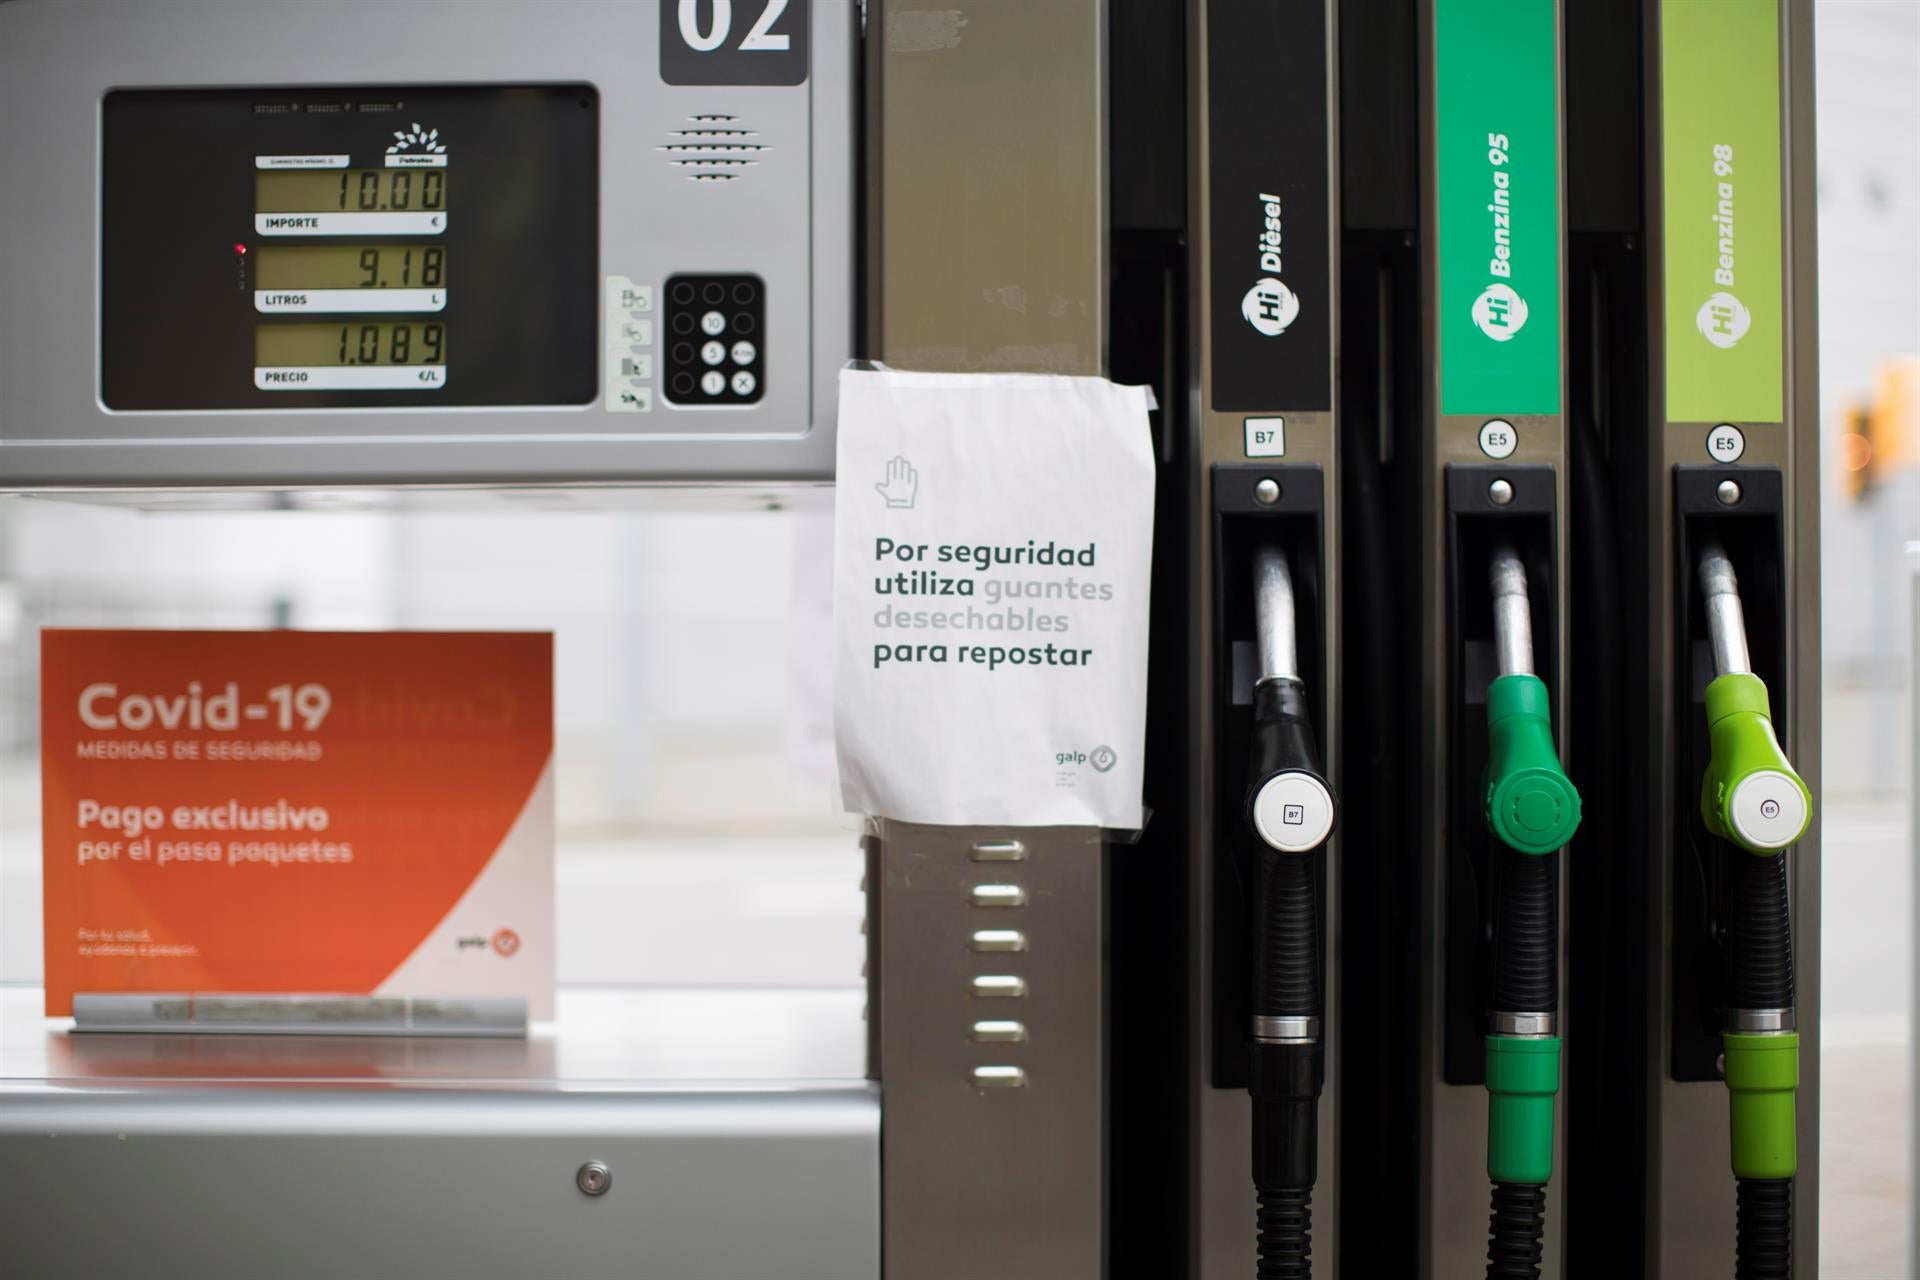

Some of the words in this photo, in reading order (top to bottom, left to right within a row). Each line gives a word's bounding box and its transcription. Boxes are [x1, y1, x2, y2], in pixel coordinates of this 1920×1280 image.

[678, 0, 790, 51] 02
[1488, 132, 1509, 166] 95
[1713, 144, 1733, 177] 98
[340, 171, 443, 209] 10.00
[266, 217, 318, 228] IMPORTE
[1488, 171, 1510, 278] Benzina
[1712, 182, 1734, 287] Benzina
[359, 249, 443, 287] 9.18
[265, 295, 308, 305] LITROS
[432, 294, 439, 304] L
[1257, 292, 1279, 321] Hi
[1486, 297, 1509, 327] Hi
[708, 317, 720, 329] 10
[1711, 305, 1732, 335] Hi
[339, 324, 443, 364] 1.089
[709, 347, 717, 359] 5
[265, 372, 308, 382] PRECIO
[418, 371, 438, 382] €/L
[1255, 431, 1275, 444] B7
[1488, 433, 1507, 446] E5
[1716, 437, 1735, 450] E5
[875, 538, 928, 562] Por
[938, 540, 1096, 571] seguridad
[874, 570, 974, 596] utiliza
[984, 577, 1113, 605] guantes
[873, 604, 1070, 632] desechables
[873, 644, 948, 669] para
[958, 643, 1092, 671] repostar
[78, 680, 332, 731] Covid-19
[77, 740, 168, 760] MEDIDAS
[173, 740, 200, 760] DE
[205, 740, 323, 761] SEGURIDAD
[1056, 750, 1087, 765] galp
[78, 799, 164, 838] Pago
[171, 799, 329, 831] exclusivo
[78, 840, 122, 866] por
[127, 836, 151, 861] el
[157, 840, 222, 867] pasa
[228, 838, 353, 868] paquetes
